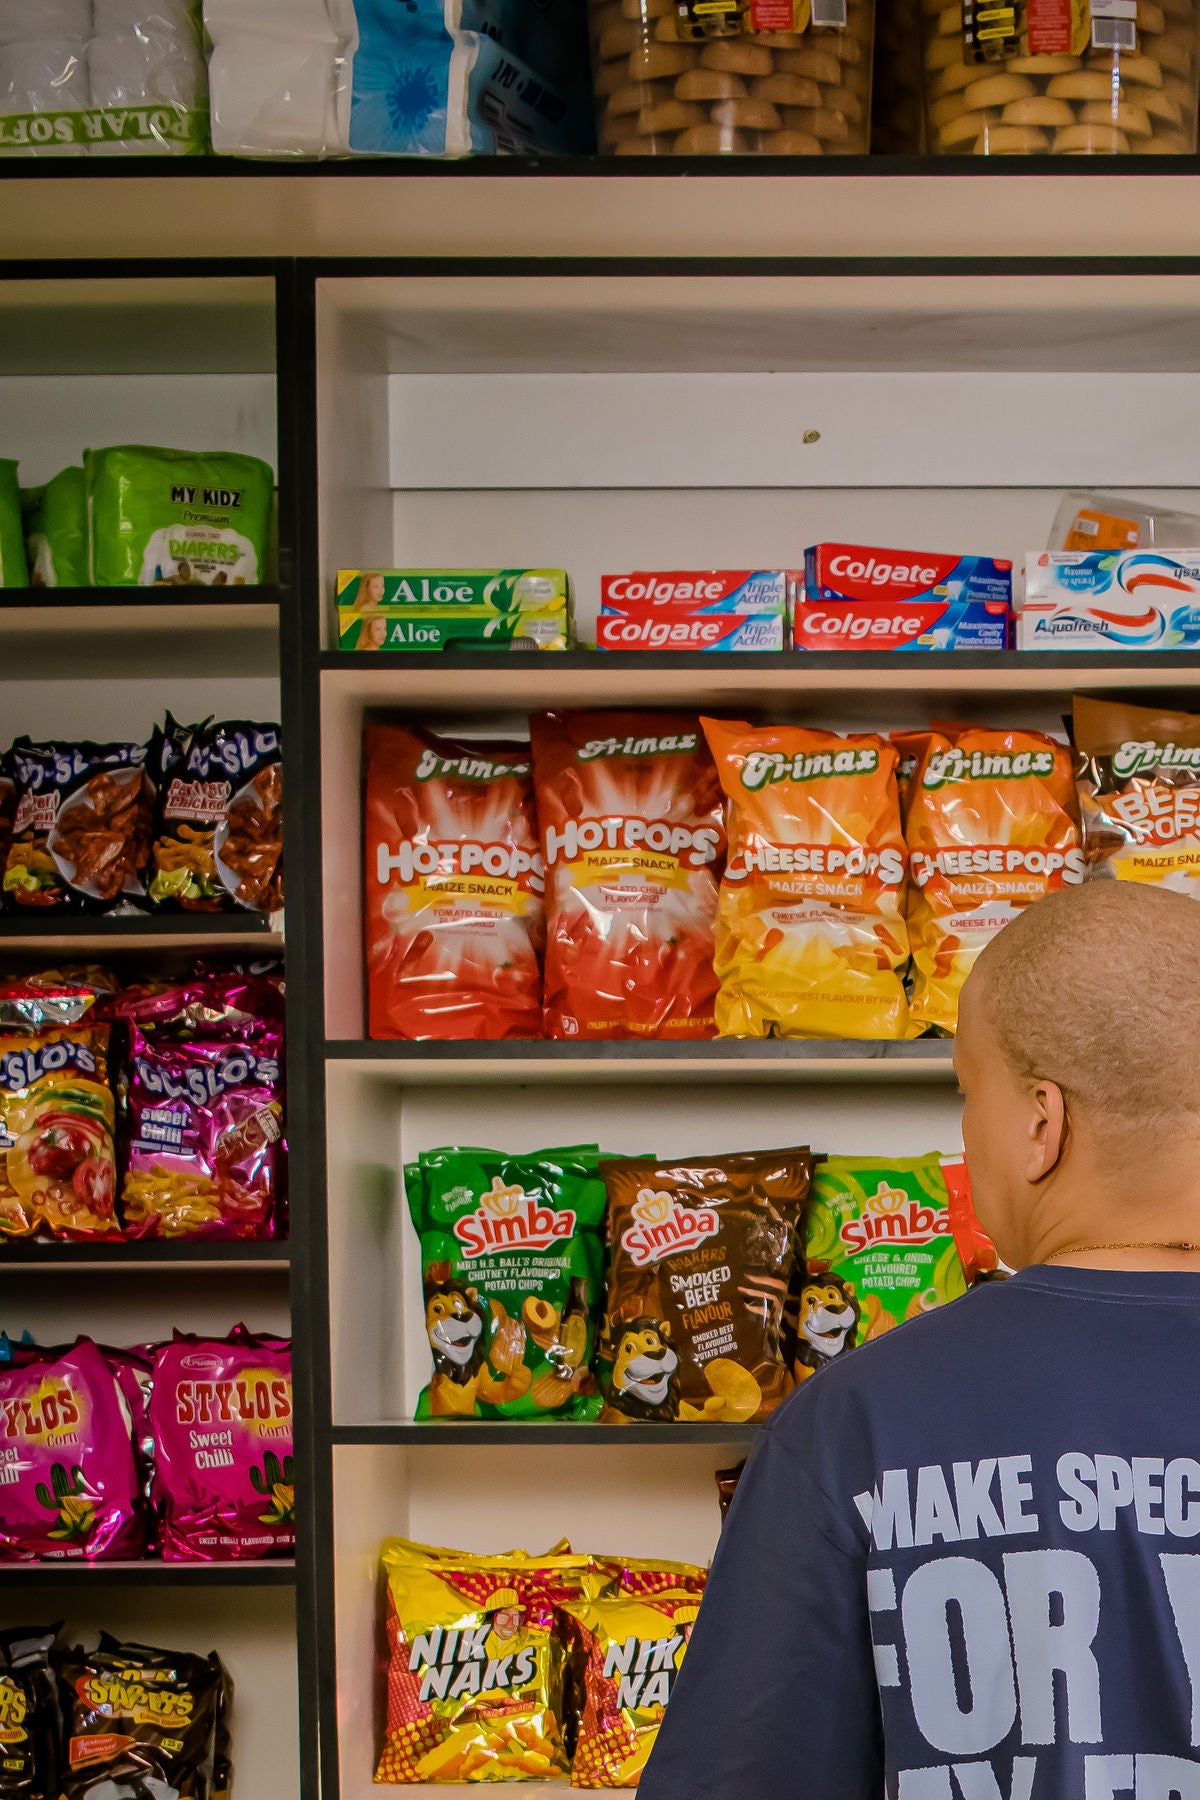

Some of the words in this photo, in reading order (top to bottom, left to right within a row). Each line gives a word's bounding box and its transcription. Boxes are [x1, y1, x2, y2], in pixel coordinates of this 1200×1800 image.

[171, 485, 196, 504] MY
[203, 488, 242, 509] KIDZ
[168, 539, 239, 561] DIAPERS
[829, 555, 938, 585] Colgate
[391, 578, 474, 603] Aloe
[607, 577, 725, 606] Colgate
[738, 593, 780, 605] Action
[745, 581, 784, 594] Triple
[390, 623, 441, 644] Aloe
[602, 618, 723, 648] Colgate
[743, 624, 781, 636] Triple
[802, 612, 924, 641] Colgate
[1035, 619, 1109, 637] Aquafresh
[733, 635, 777, 647] Action
[577, 734, 697, 761] Frimax
[743, 749, 878, 789] Frimax
[923, 749, 1052, 789] Frimax
[546, 818, 720, 865] HOTPOPS
[633, 857, 676, 871] SNACK
[724, 849, 825, 880] CHEESE
[827, 850, 904, 885] POPS
[912, 850, 1004, 886] CHEESE
[1006, 849, 1087, 886] POPS
[1134, 855, 1174, 868] MAIZE
[468, 882, 514, 896] SNACK
[769, 880, 814, 895] MAIZE
[816, 882, 863, 896] SNACK
[995, 882, 1045, 895] SNACK
[771, 910, 808, 919] CHEESE
[950, 918, 984, 928] CHEESE
[455, 1201, 576, 1256] Simba
[622, 1208, 717, 1263] Simba
[840, 1203, 953, 1256] Simba
[854, 1254, 889, 1265] CHEESE
[864, 1264, 918, 1276] FLAVOURED
[485, 1280, 516, 1292] POTATO
[518, 1279, 544, 1291] CHIPS
[670, 1266, 731, 1292] SMOKED
[685, 1285, 720, 1308] BEEF
[682, 1301, 733, 1329] FLAVOUR
[692, 1328, 719, 1344] SMOKED
[176, 1379, 292, 1424] STYLOS
[46, 1431, 79, 1449] Corn
[190, 1429, 233, 1450] Sweet
[258, 1424, 290, 1439] Corn
[195, 1449, 235, 1470] Chilli
[853, 1454, 1039, 1551] MAKE
[408, 1624, 493, 1671] NIK
[603, 1635, 684, 1678] NIK
[418, 1647, 535, 1702] NAKS
